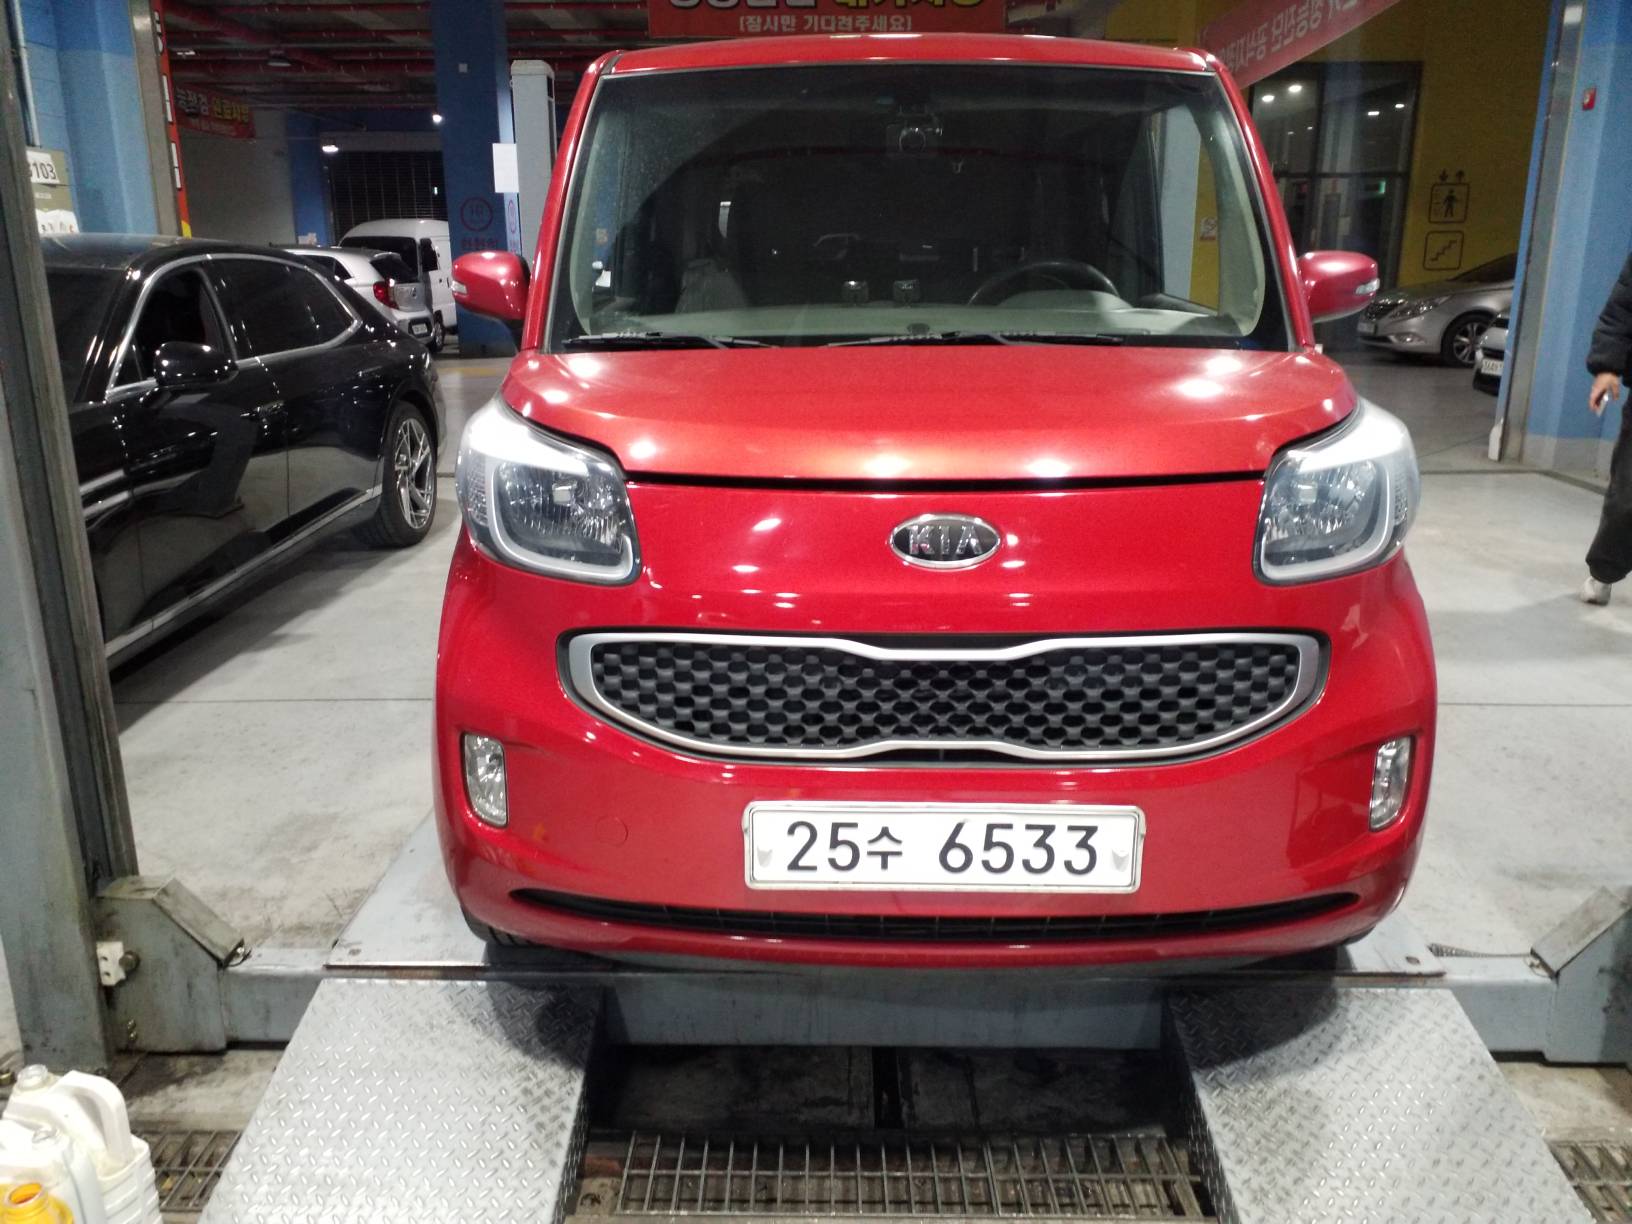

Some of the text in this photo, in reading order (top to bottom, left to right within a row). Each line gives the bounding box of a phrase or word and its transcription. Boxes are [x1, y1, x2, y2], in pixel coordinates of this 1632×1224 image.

[29, 162, 57, 180] 103
[906, 525, 983, 555] KIA
[786, 820, 1100, 876] 25수 6533
